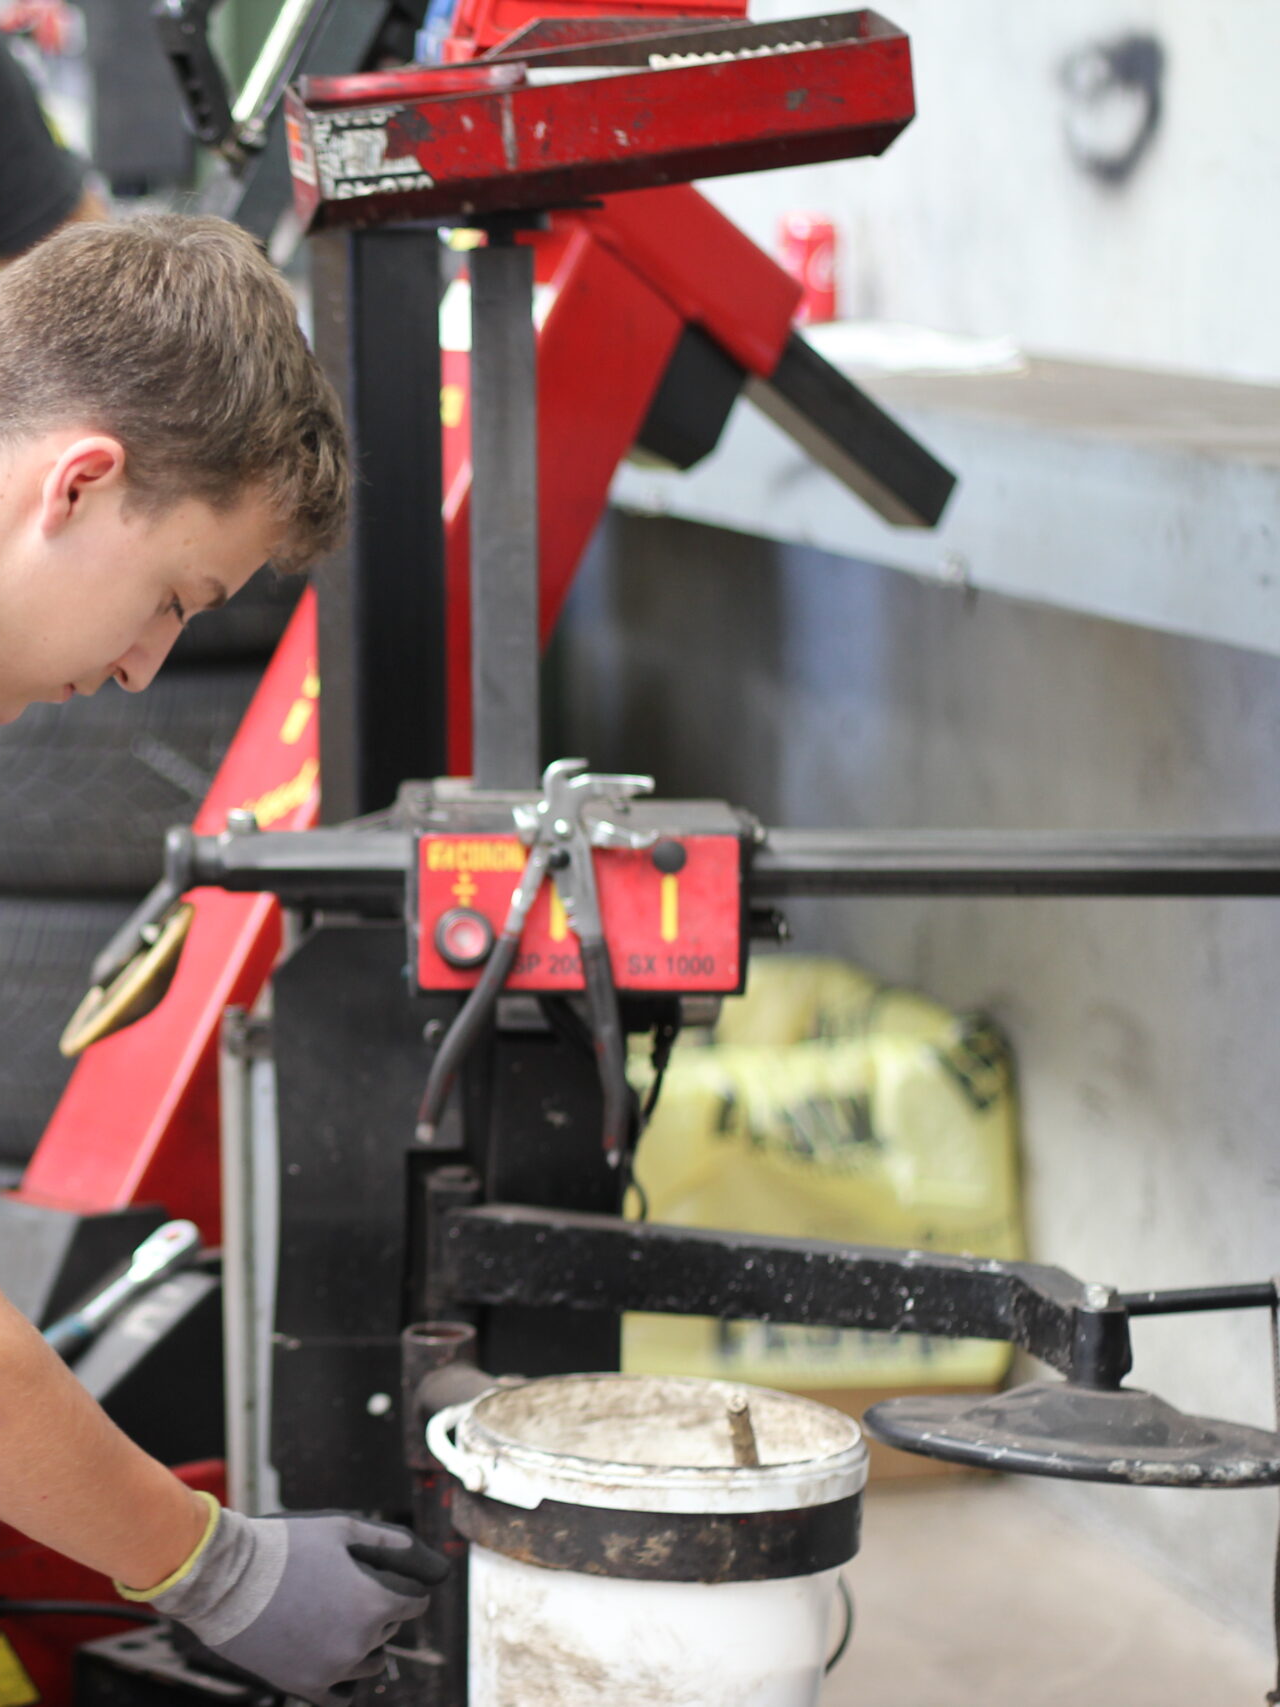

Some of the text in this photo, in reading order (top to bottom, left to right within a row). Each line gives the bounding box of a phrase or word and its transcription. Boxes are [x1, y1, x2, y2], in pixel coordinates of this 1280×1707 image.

[548, 953, 583, 975] 200
[627, 954, 715, 976] SX 1000
